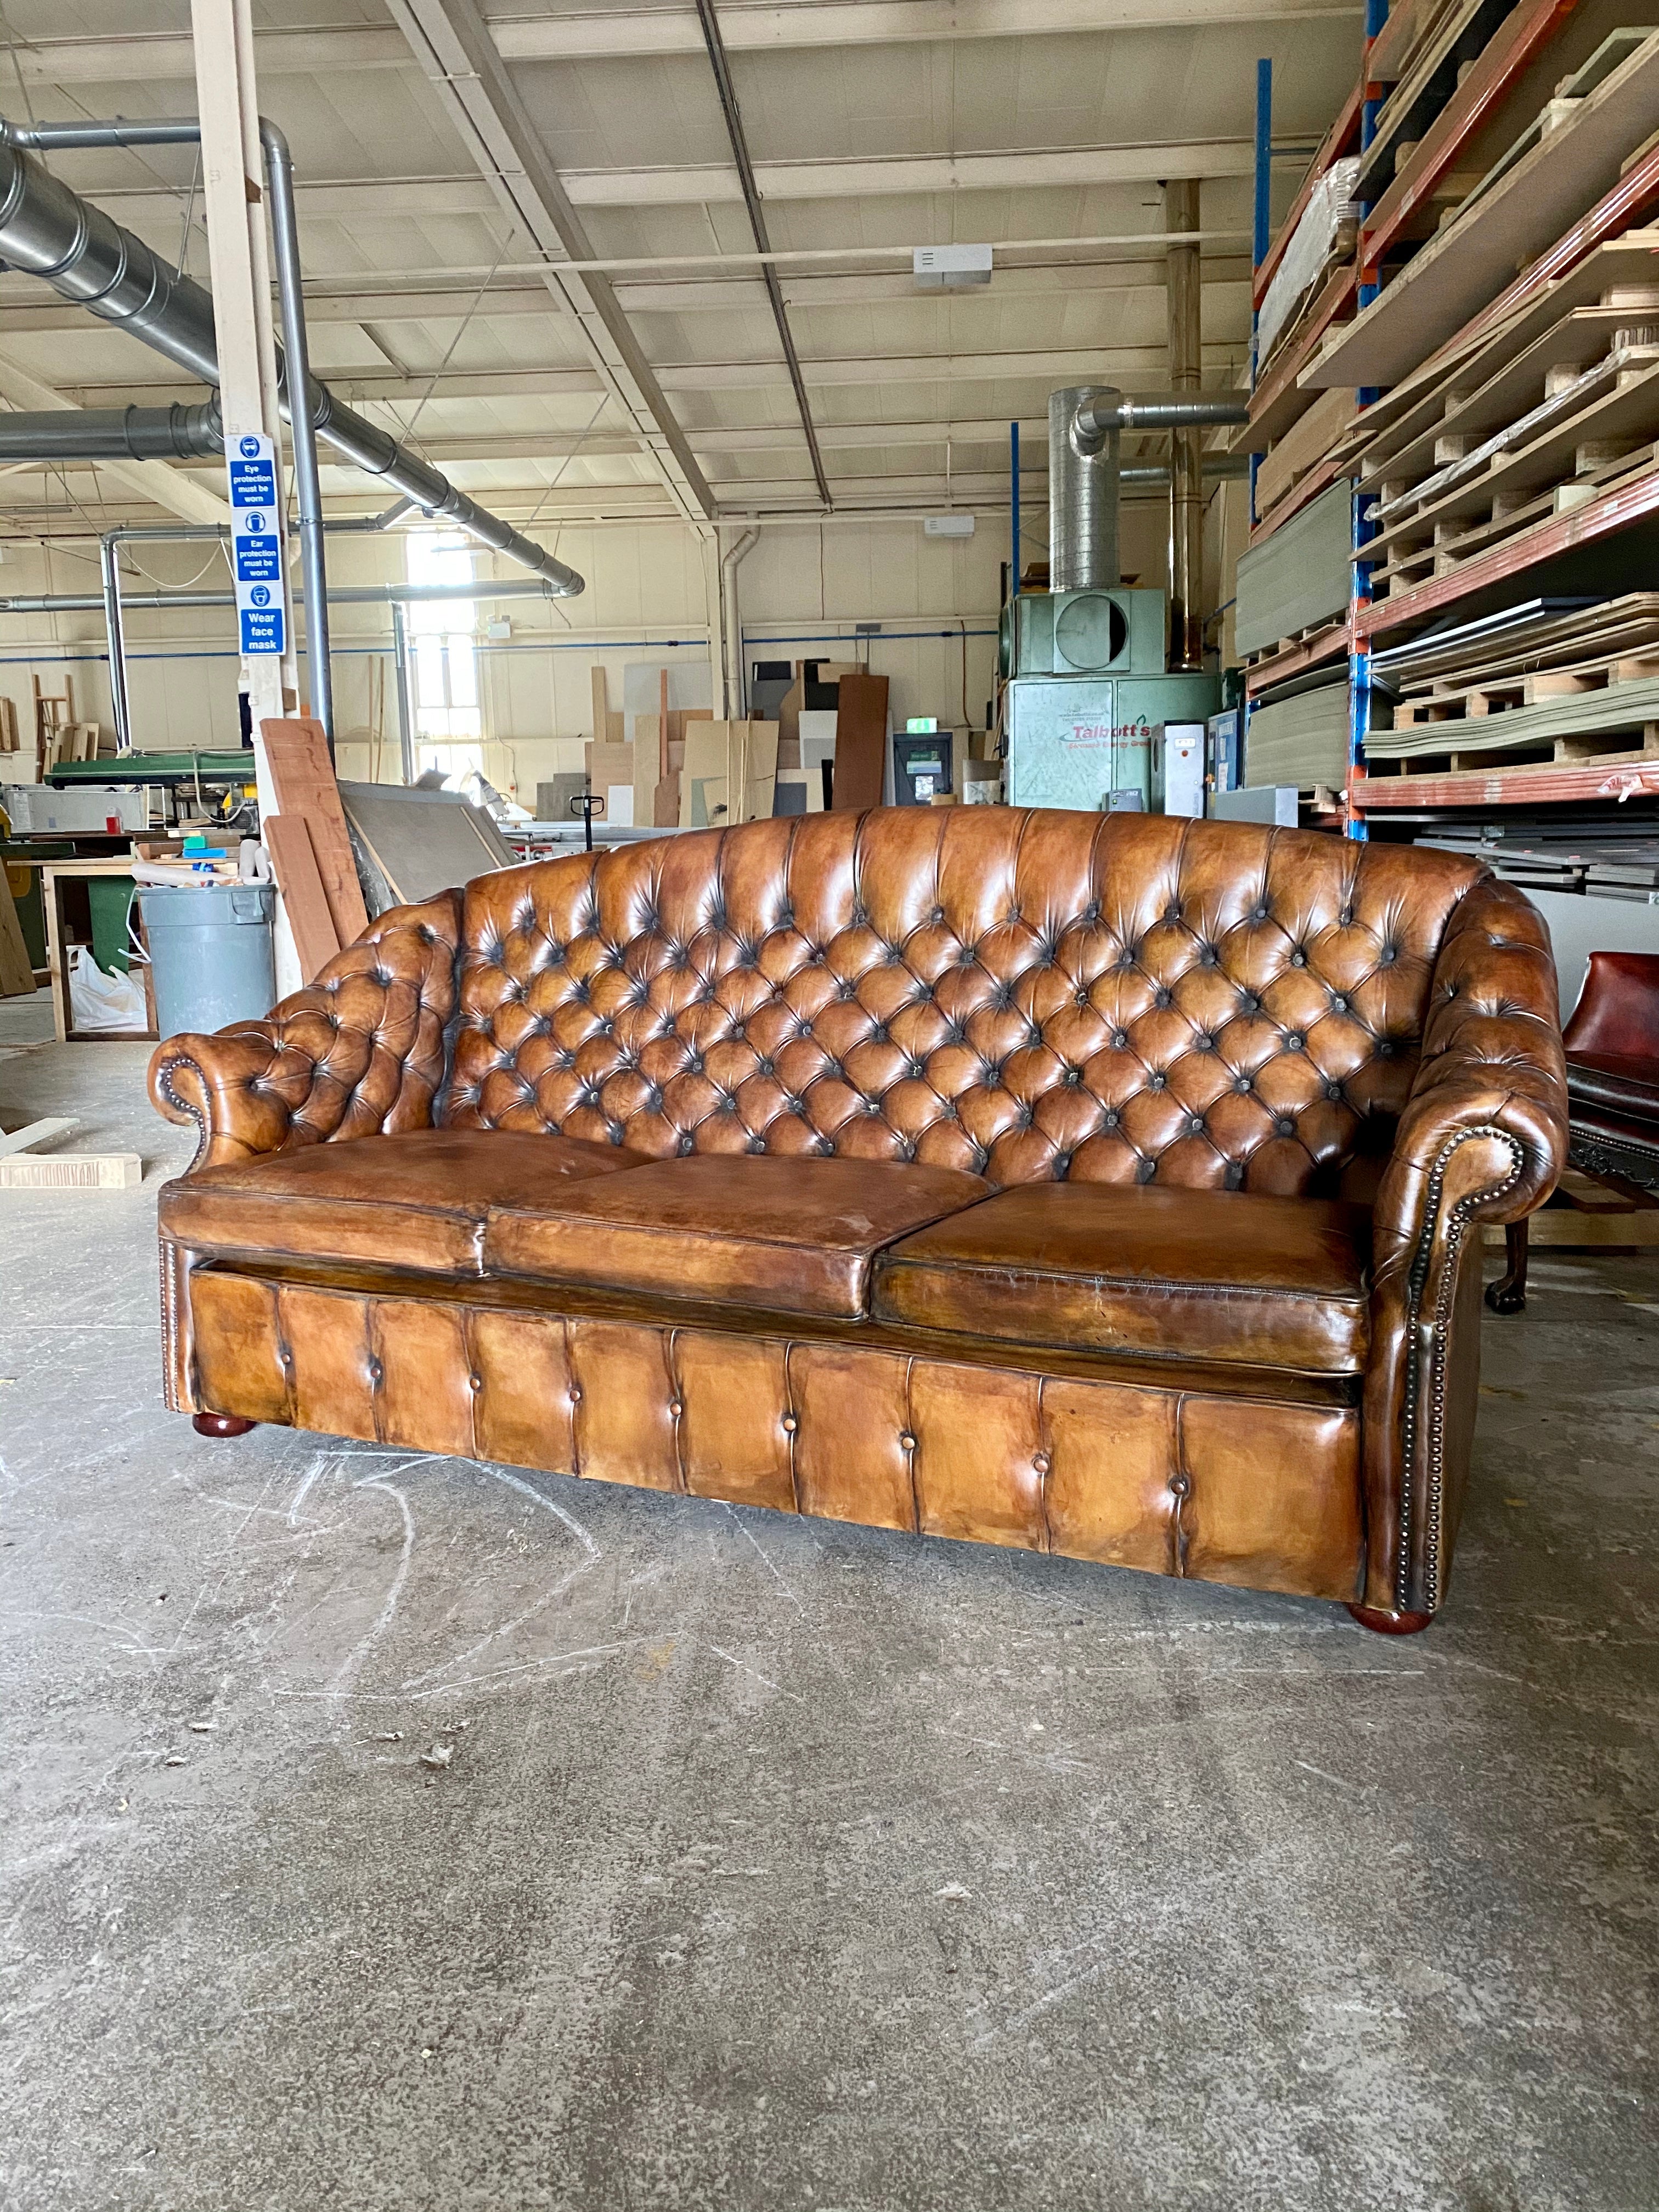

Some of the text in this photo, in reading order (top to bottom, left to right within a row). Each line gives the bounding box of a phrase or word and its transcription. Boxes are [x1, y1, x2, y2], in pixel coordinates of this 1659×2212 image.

[244, 465, 259, 474] Eye
[233, 475, 272, 484] protection
[239, 550, 276, 559] protection
[248, 613, 275, 623] Wear
[251, 627, 274, 636] face
[249, 640, 276, 650] mask
